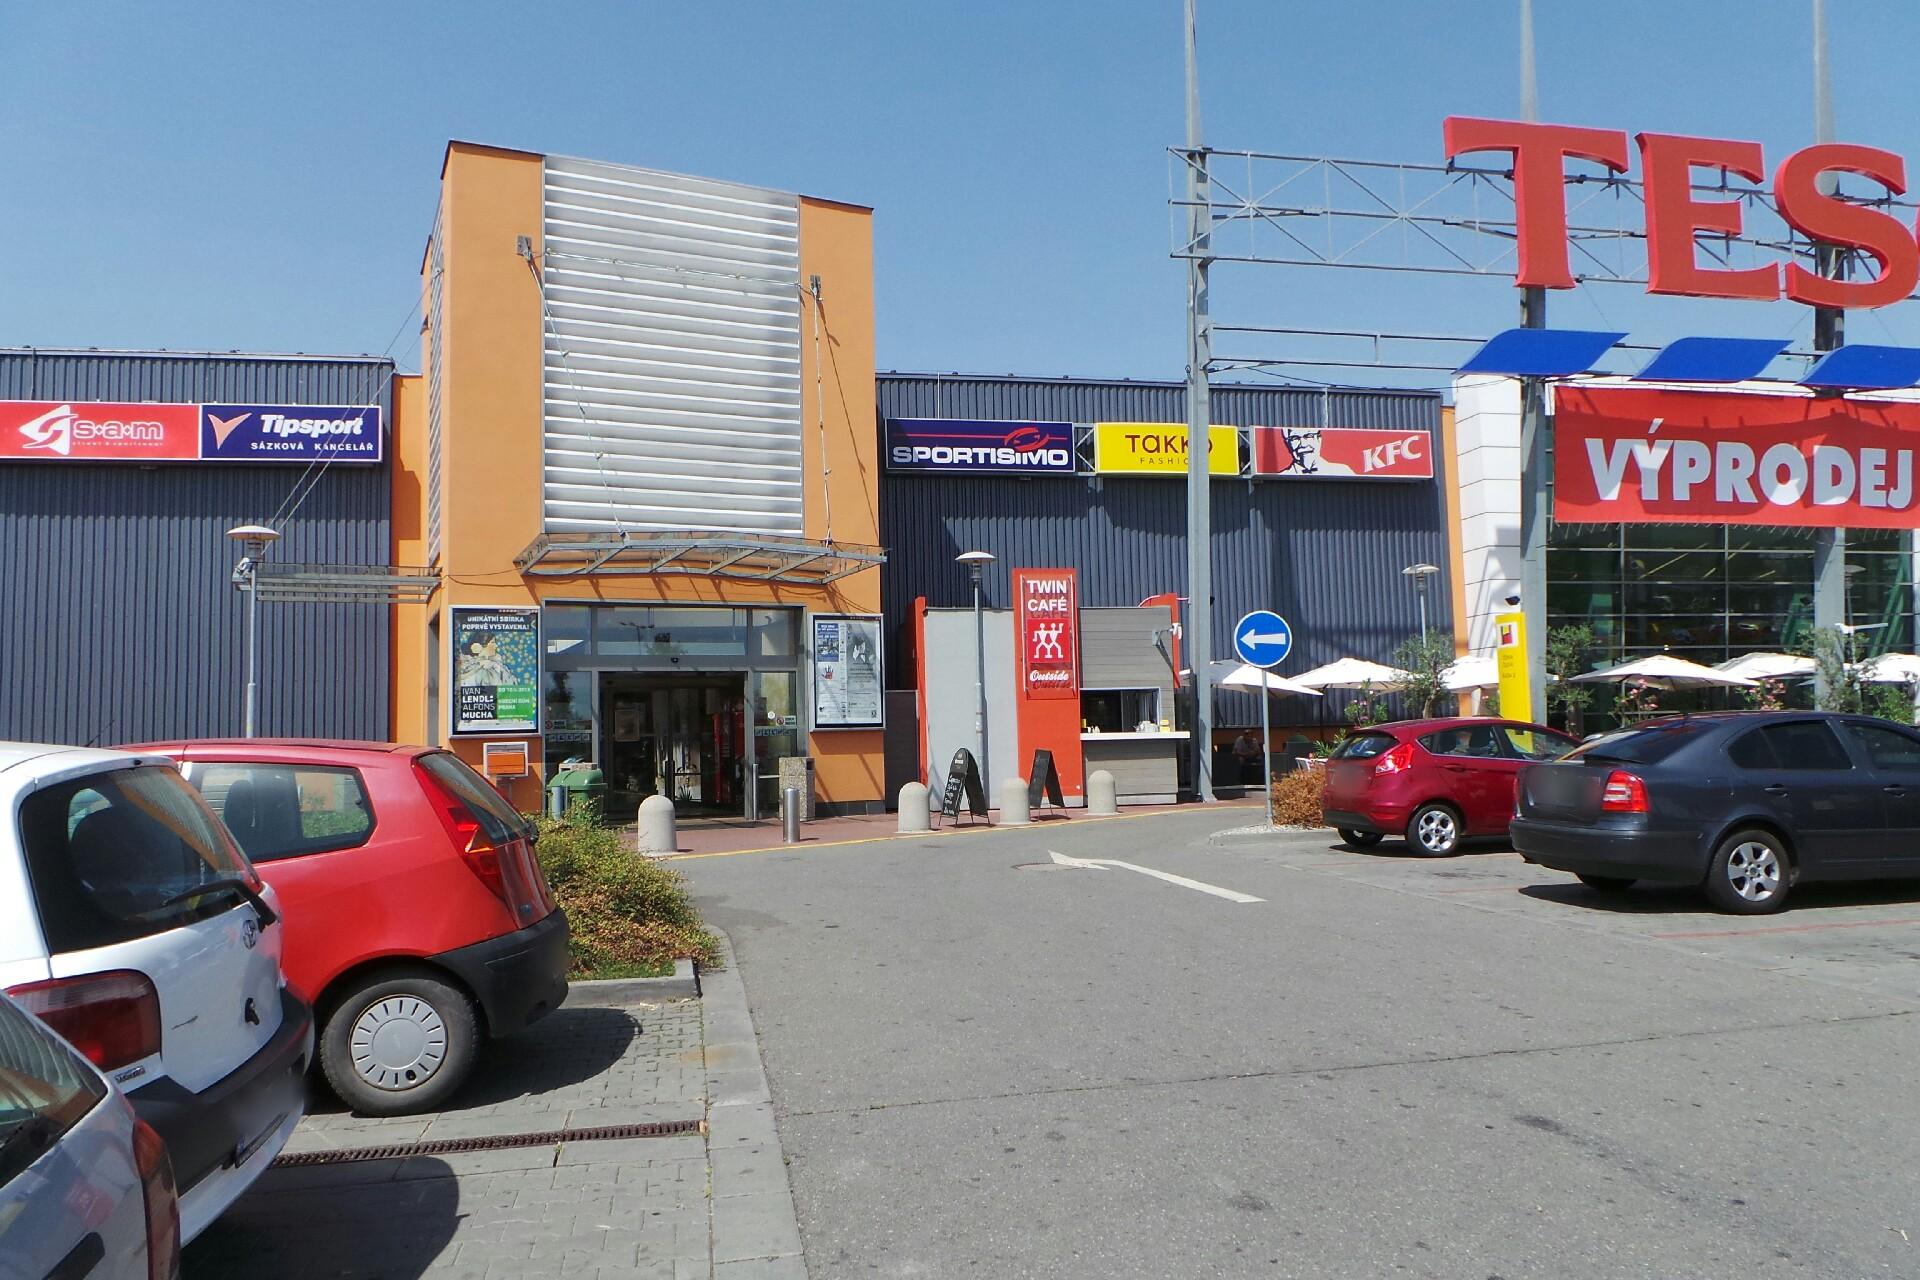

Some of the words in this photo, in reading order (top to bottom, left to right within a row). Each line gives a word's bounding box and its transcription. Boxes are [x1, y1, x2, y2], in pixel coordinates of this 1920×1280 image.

[1443, 115, 1920, 310] TES
[261, 414, 363, 438] Tipsport
[250, 441, 304, 450] SÁZKOVÁ
[314, 441, 374, 451] KANCELÁŘ
[1362, 434, 1422, 473] KFC
[1584, 417, 1913, 509] VÝPRODEJ
[1027, 579, 1067, 594] TWIN
[1027, 596, 1068, 612] CAFÉ
[1029, 668, 1070, 682] Outside
[462, 687, 481, 695] IVAN
[462, 703, 496, 711] ALFONS
[462, 711, 493, 719] MUCHA
